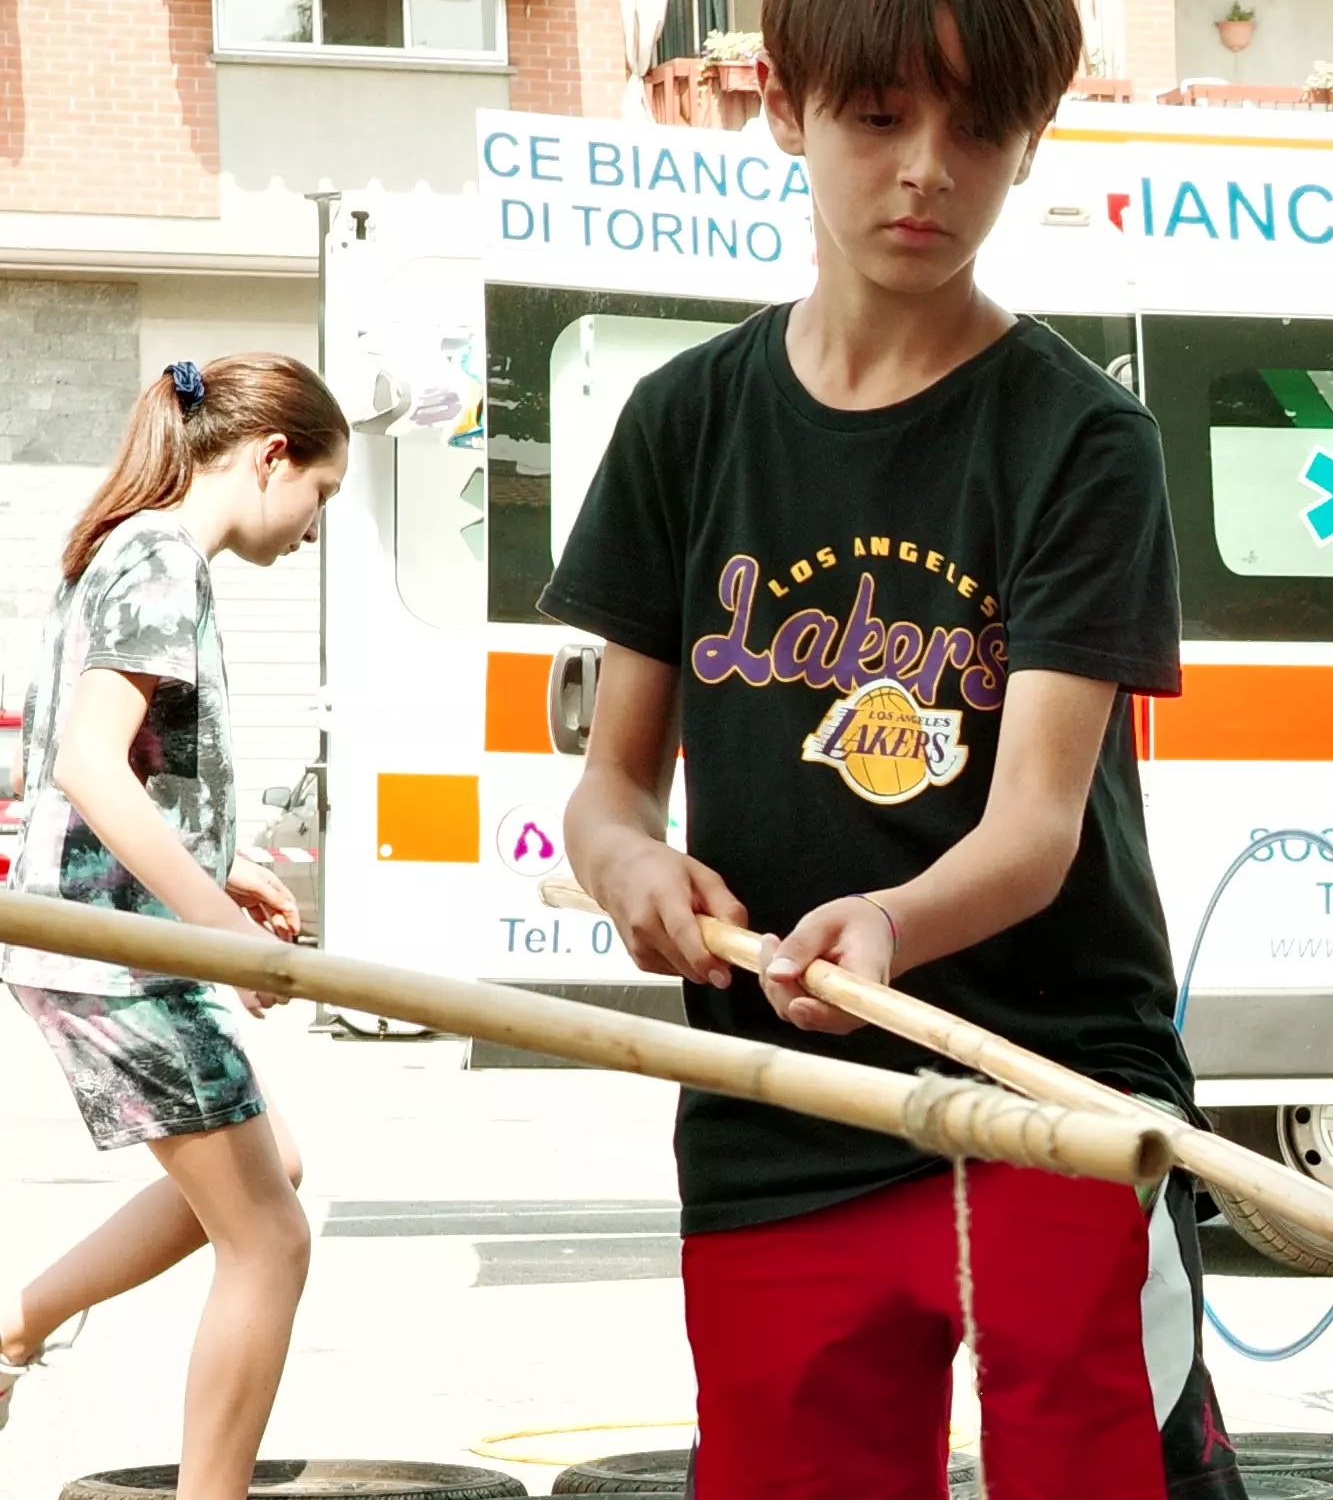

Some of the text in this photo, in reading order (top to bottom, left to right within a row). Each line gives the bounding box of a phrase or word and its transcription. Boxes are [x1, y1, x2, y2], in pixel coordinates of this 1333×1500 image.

[483, 131, 811, 203] CE BIANCA
[500, 198, 783, 263] DI TORINO
[767, 535, 999, 619] LOS ANGELES
[691, 553, 1008, 712] Lakers
[822, 706, 958, 778] LAKERS
[868, 709, 953, 728] LOS ANGELES
[499, 917, 572, 954] Tel.
